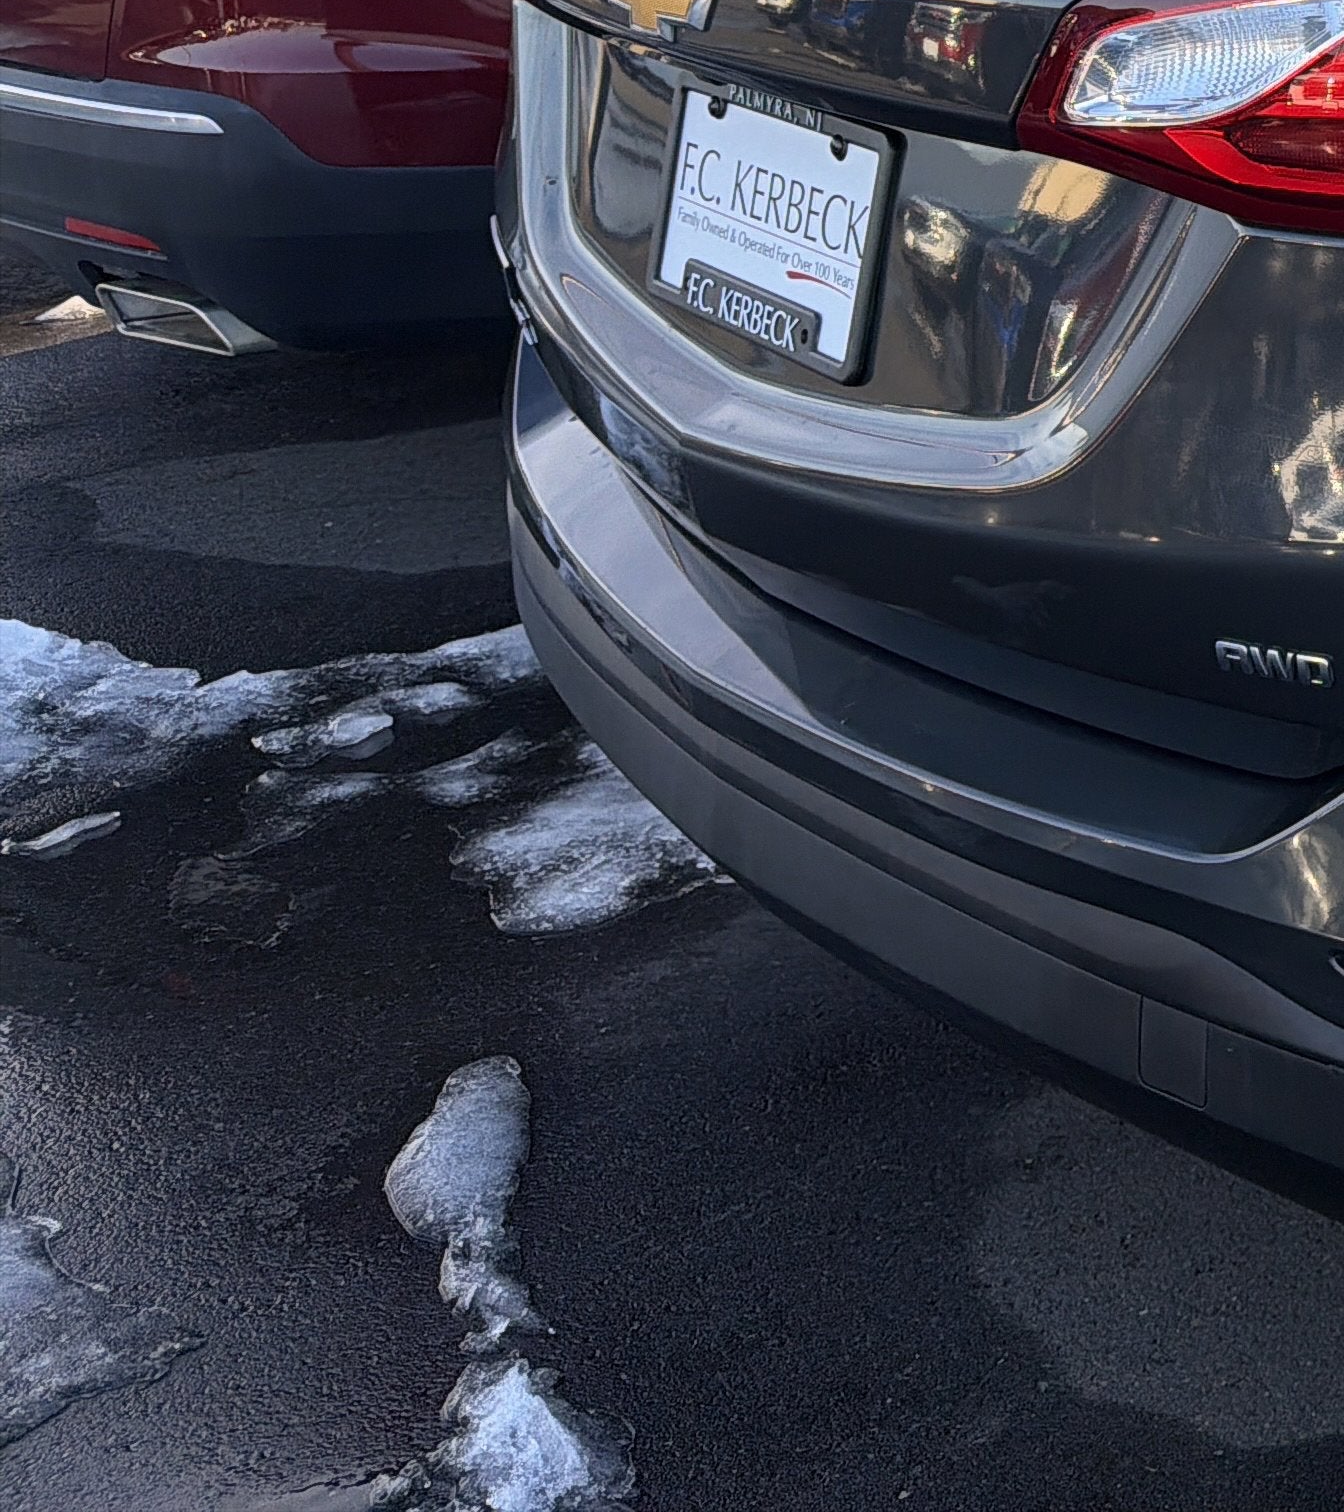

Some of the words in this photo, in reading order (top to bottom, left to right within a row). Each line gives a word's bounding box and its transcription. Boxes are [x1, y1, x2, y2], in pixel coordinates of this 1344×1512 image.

[727, 82, 799, 126] PALMYRA,
[805, 109, 824, 132] NJ
[679, 141, 722, 206] F.C.
[730, 159, 870, 260] KERBECK
[677, 205, 700, 231] Family
[701, 215, 729, 240] Owned
[729, 228, 737, 244] &
[737, 230, 776, 260] Operated
[776, 245, 791, 265] For
[791, 251, 813, 273] Over
[814, 260, 830, 281] 100
[832, 266, 856, 291] Years
[717, 285, 801, 353] KERBECK
[1214, 639, 1334, 688] AWD
